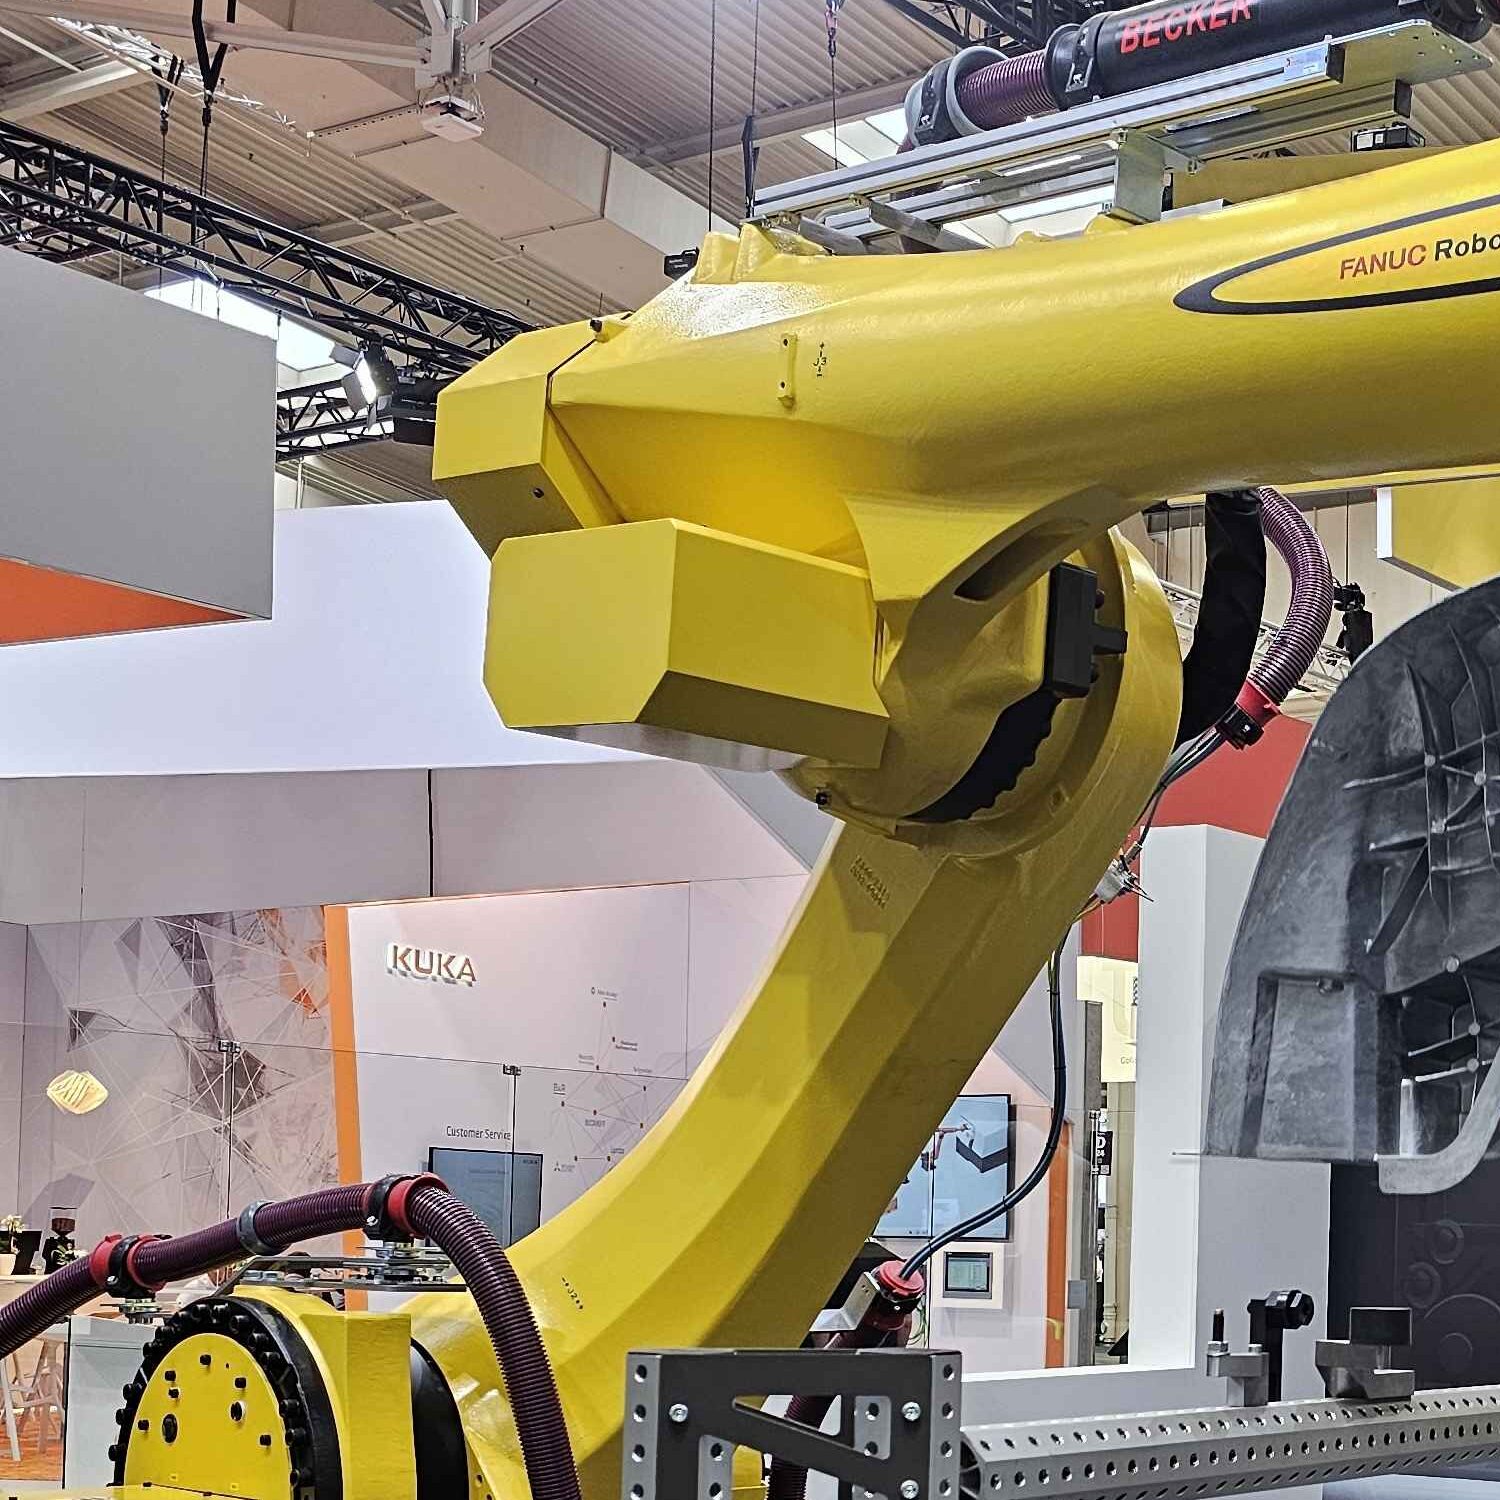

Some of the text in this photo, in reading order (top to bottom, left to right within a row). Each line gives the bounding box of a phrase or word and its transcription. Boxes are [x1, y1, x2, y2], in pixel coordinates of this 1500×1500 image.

[1120, 0, 1251, 53] BECKER
[1340, 244, 1427, 279] FANUC
[391, 944, 477, 982] KUKA
[446, 1125, 511, 1141] Customer Service
